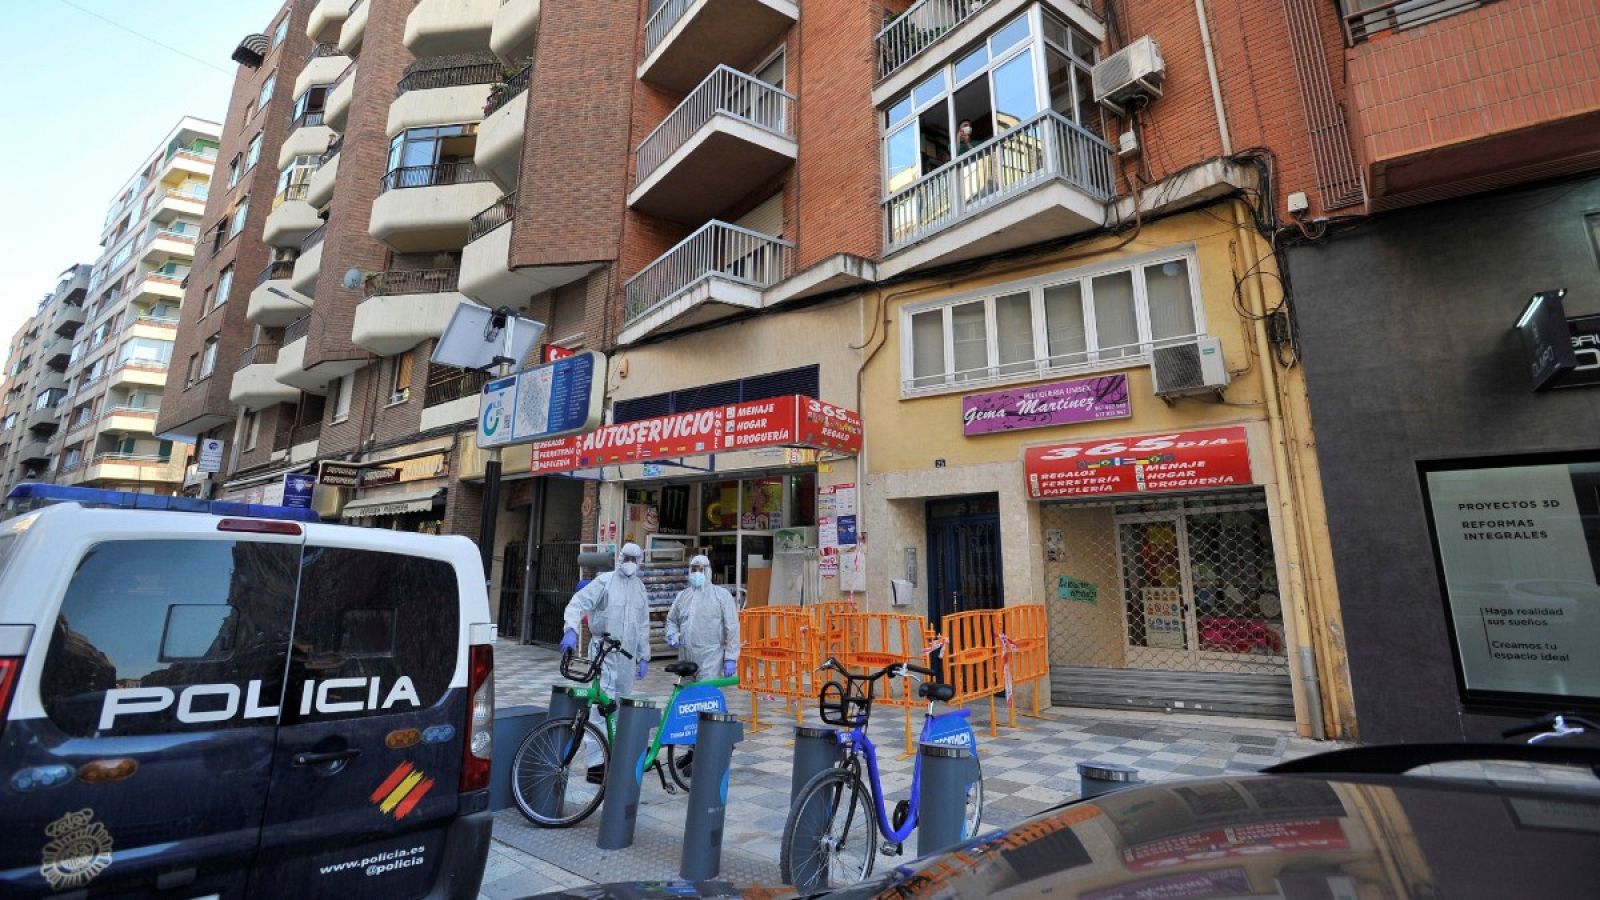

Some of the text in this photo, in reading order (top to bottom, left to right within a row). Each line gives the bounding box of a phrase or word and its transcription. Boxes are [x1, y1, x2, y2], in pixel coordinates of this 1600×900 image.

[1066, 384, 1092, 395] UNISEX
[737, 403, 775, 417] MENAJE
[808, 400, 847, 420] 365
[964, 407, 1007, 426] Gema
[1016, 396, 1094, 416] Martínez
[582, 410, 714, 451] AUTOSERVICIO
[736, 418, 768, 431] HOGAR
[736, 428, 789, 445] DROGUERÍA
[821, 427, 850, 441] REGALO
[1040, 434, 1229, 460] 365 DIA
[1145, 460, 1206, 471] MENAJE
[1041, 469, 1097, 480] REGALOS
[1147, 470, 1196, 480] HOGAR
[1042, 475, 1120, 487] FERRETERÍA
[1148, 475, 1234, 489] DROGUERÍA
[1043, 484, 1113, 496] PAPELERÍA
[1458, 500, 1560, 511] PROYECTOS 3D
[1462, 519, 1534, 529] REFORMAS
[1464, 531, 1548, 541] INTEGRALES
[1485, 607, 1564, 617] Haga realidad
[1508, 617, 1549, 626] sueños
[1492, 641, 1558, 650] Creamos tu
[1494, 651, 1570, 662] espacio ideal
[98, 675, 421, 730] POLICIA
[678, 699, 719, 714] DECATHLON
[319, 845, 425, 875] www.policia.es
[365, 855, 424, 877] @policia
